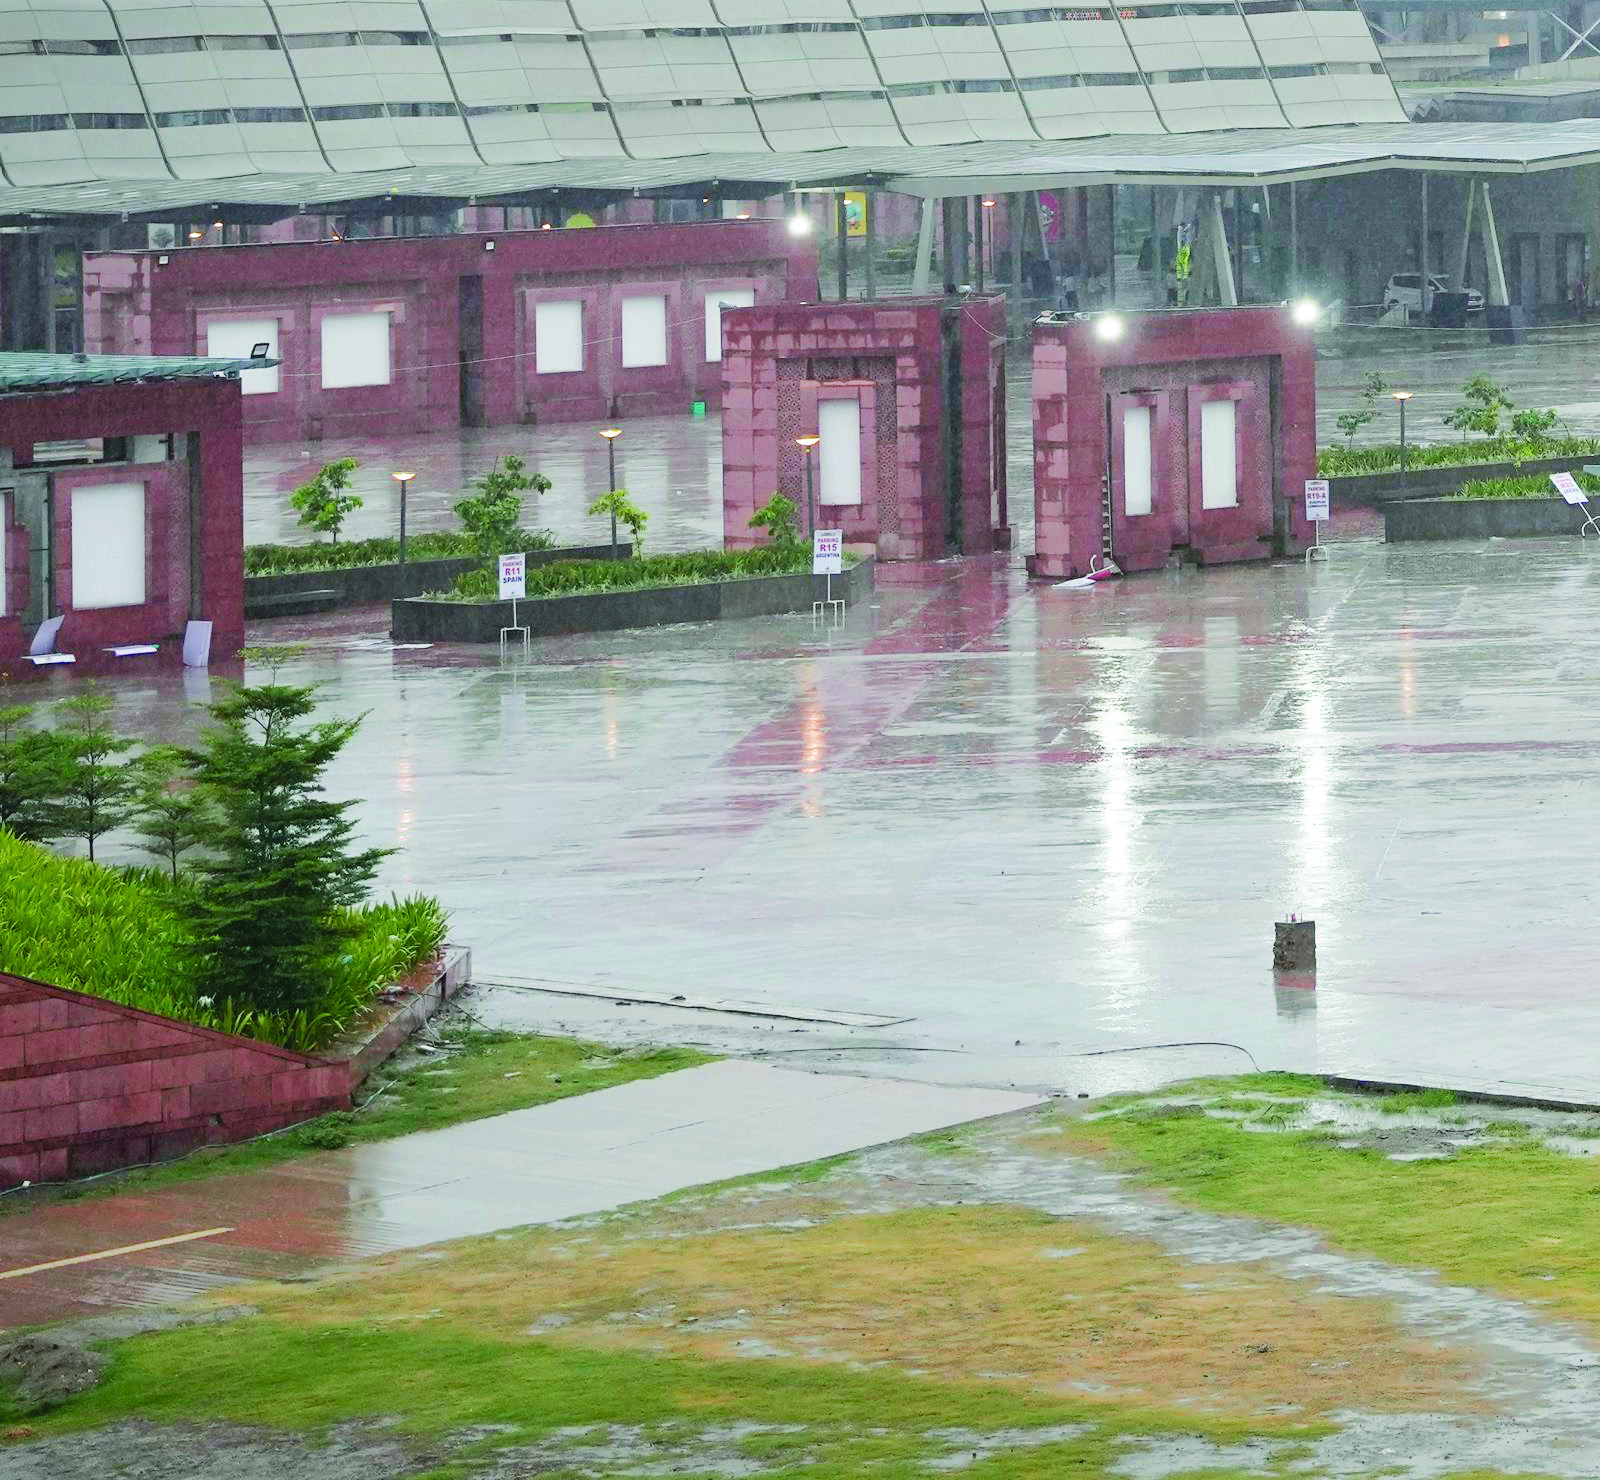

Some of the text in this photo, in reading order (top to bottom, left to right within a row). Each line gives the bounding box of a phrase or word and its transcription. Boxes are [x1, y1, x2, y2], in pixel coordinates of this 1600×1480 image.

[820, 543, 838, 551] R15
[505, 567, 520, 576] R11
[503, 576, 523, 584] SPAIN
